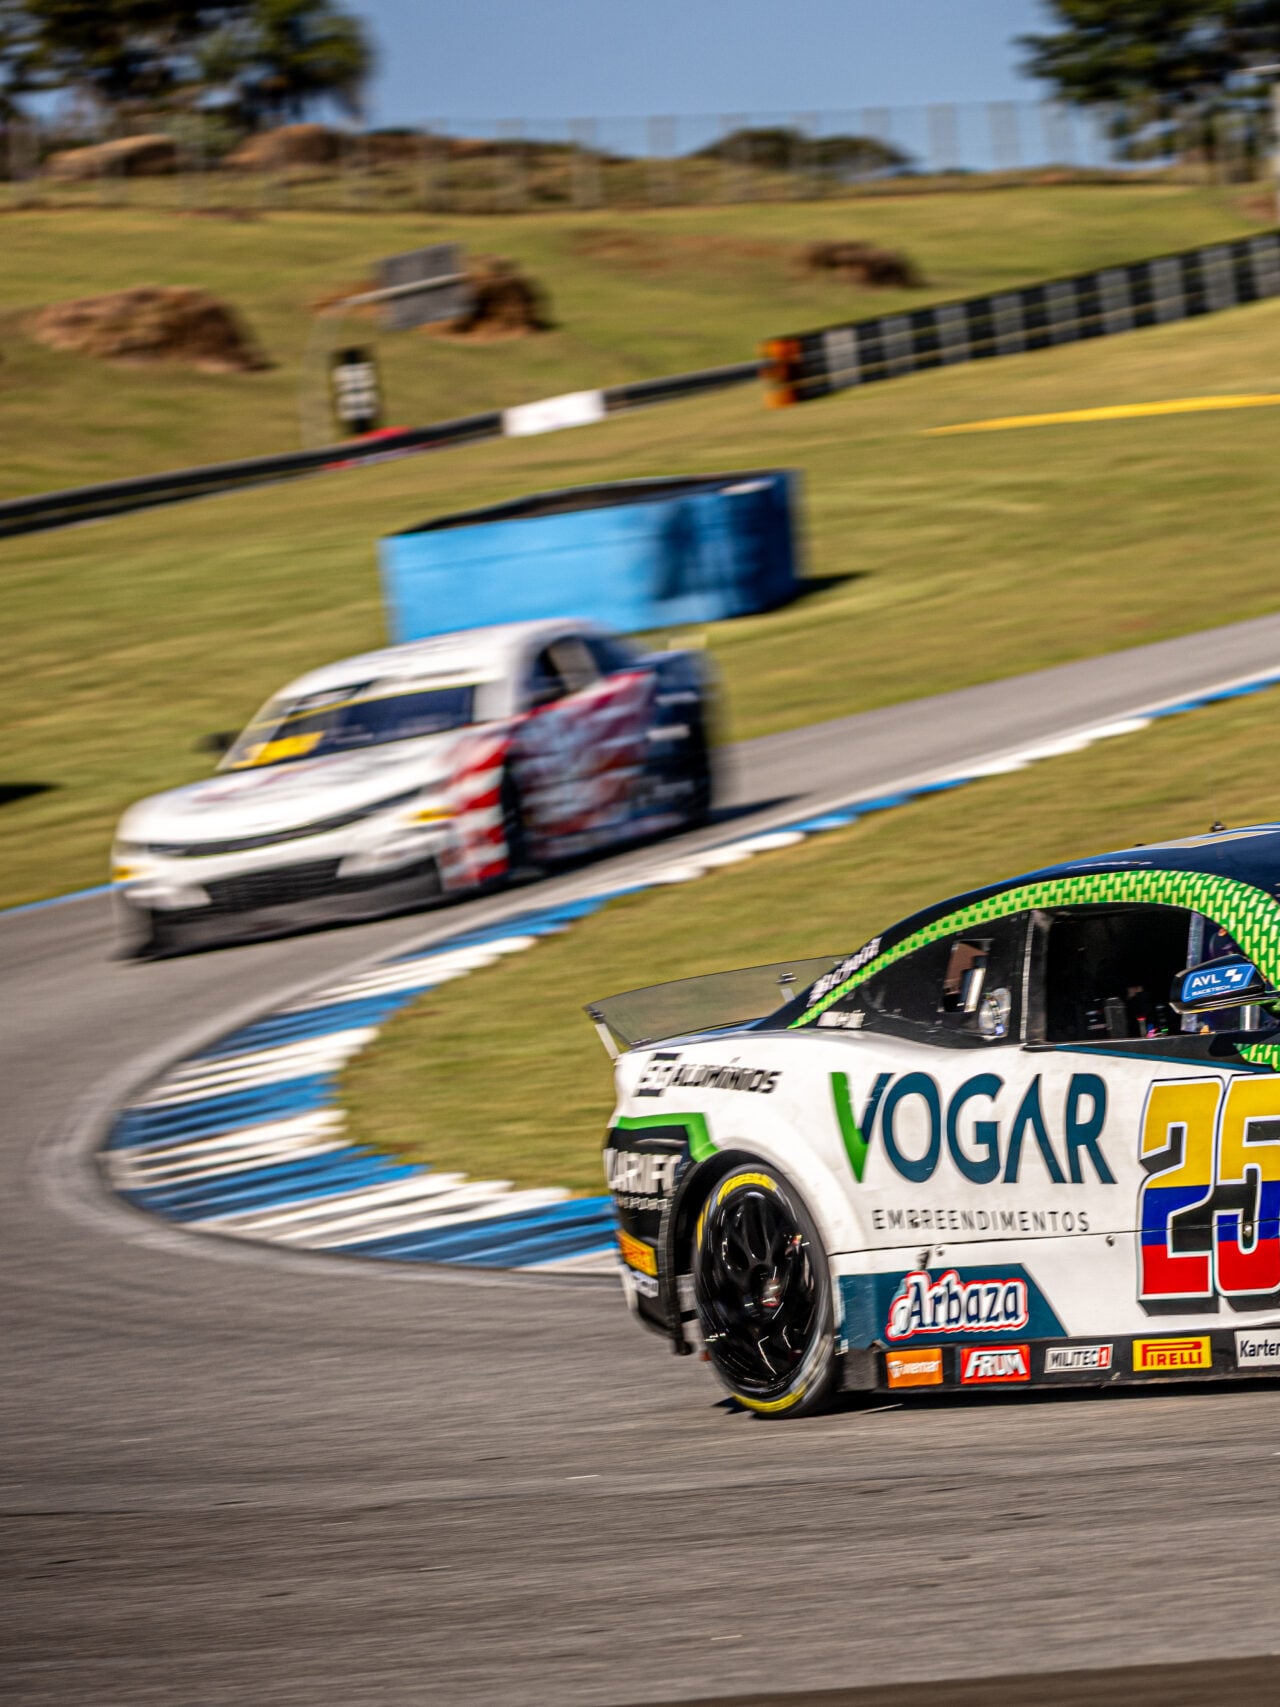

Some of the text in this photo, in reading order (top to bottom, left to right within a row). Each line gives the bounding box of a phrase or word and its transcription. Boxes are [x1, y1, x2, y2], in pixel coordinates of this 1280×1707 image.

[1192, 974, 1221, 988] AVL
[829, 1071, 1118, 1185] VOGAR
[872, 1209, 1090, 1232] EMPREENDIMENTOS
[888, 1271, 1028, 1338] Arbaza
[964, 1349, 1028, 1378] FRUM
[1141, 1341, 1203, 1367] PIRELLI
